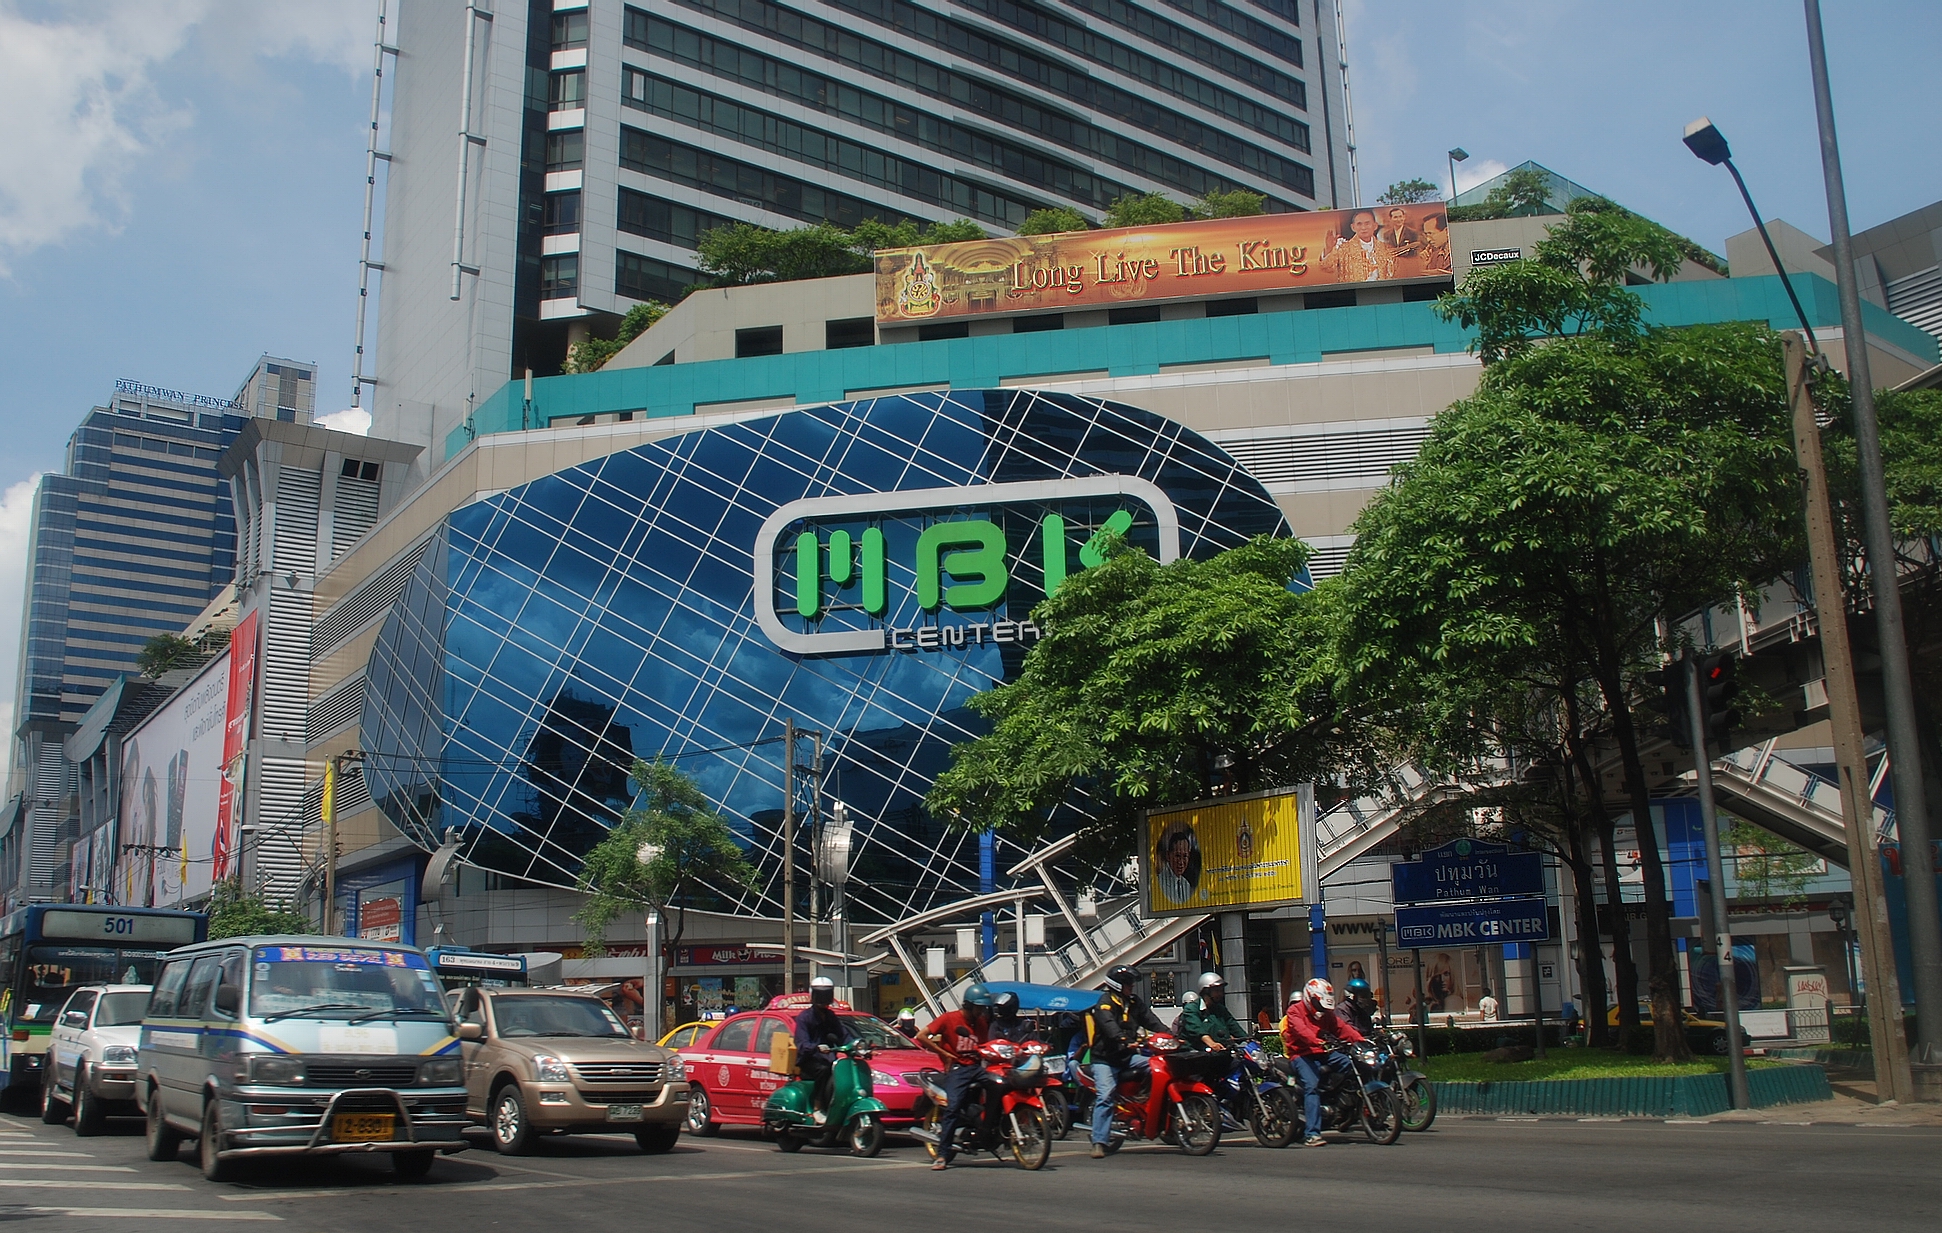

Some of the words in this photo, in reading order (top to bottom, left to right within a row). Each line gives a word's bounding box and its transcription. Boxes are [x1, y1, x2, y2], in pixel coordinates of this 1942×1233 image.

[1012, 260, 1083, 294] Long
[1096, 252, 1159, 284] Live
[1169, 246, 1226, 277] The
[1236, 239, 1308, 275] King
[1474, 252, 1519, 262] JCDecaux
[115, 379, 185, 400] PATHUMWAN
[194, 394, 245, 410] PRINCESS
[797, 510, 1133, 617] MBK
[892, 620, 1041, 649] CENTER
[1434, 859, 1498, 886] ปทุมวัน
[1436, 888, 1472, 898] Pathum
[1479, 885, 1500, 895] Wan
[104, 917, 133, 934] 501
[1403, 929, 1432, 938] MBK
[1437, 922, 1477, 939] MBK
[1480, 917, 1544, 936] CENTER
[1716, 936, 1723, 947] 4
[712, 950, 736, 963] Milk
[1723, 951, 1731, 962] 4
